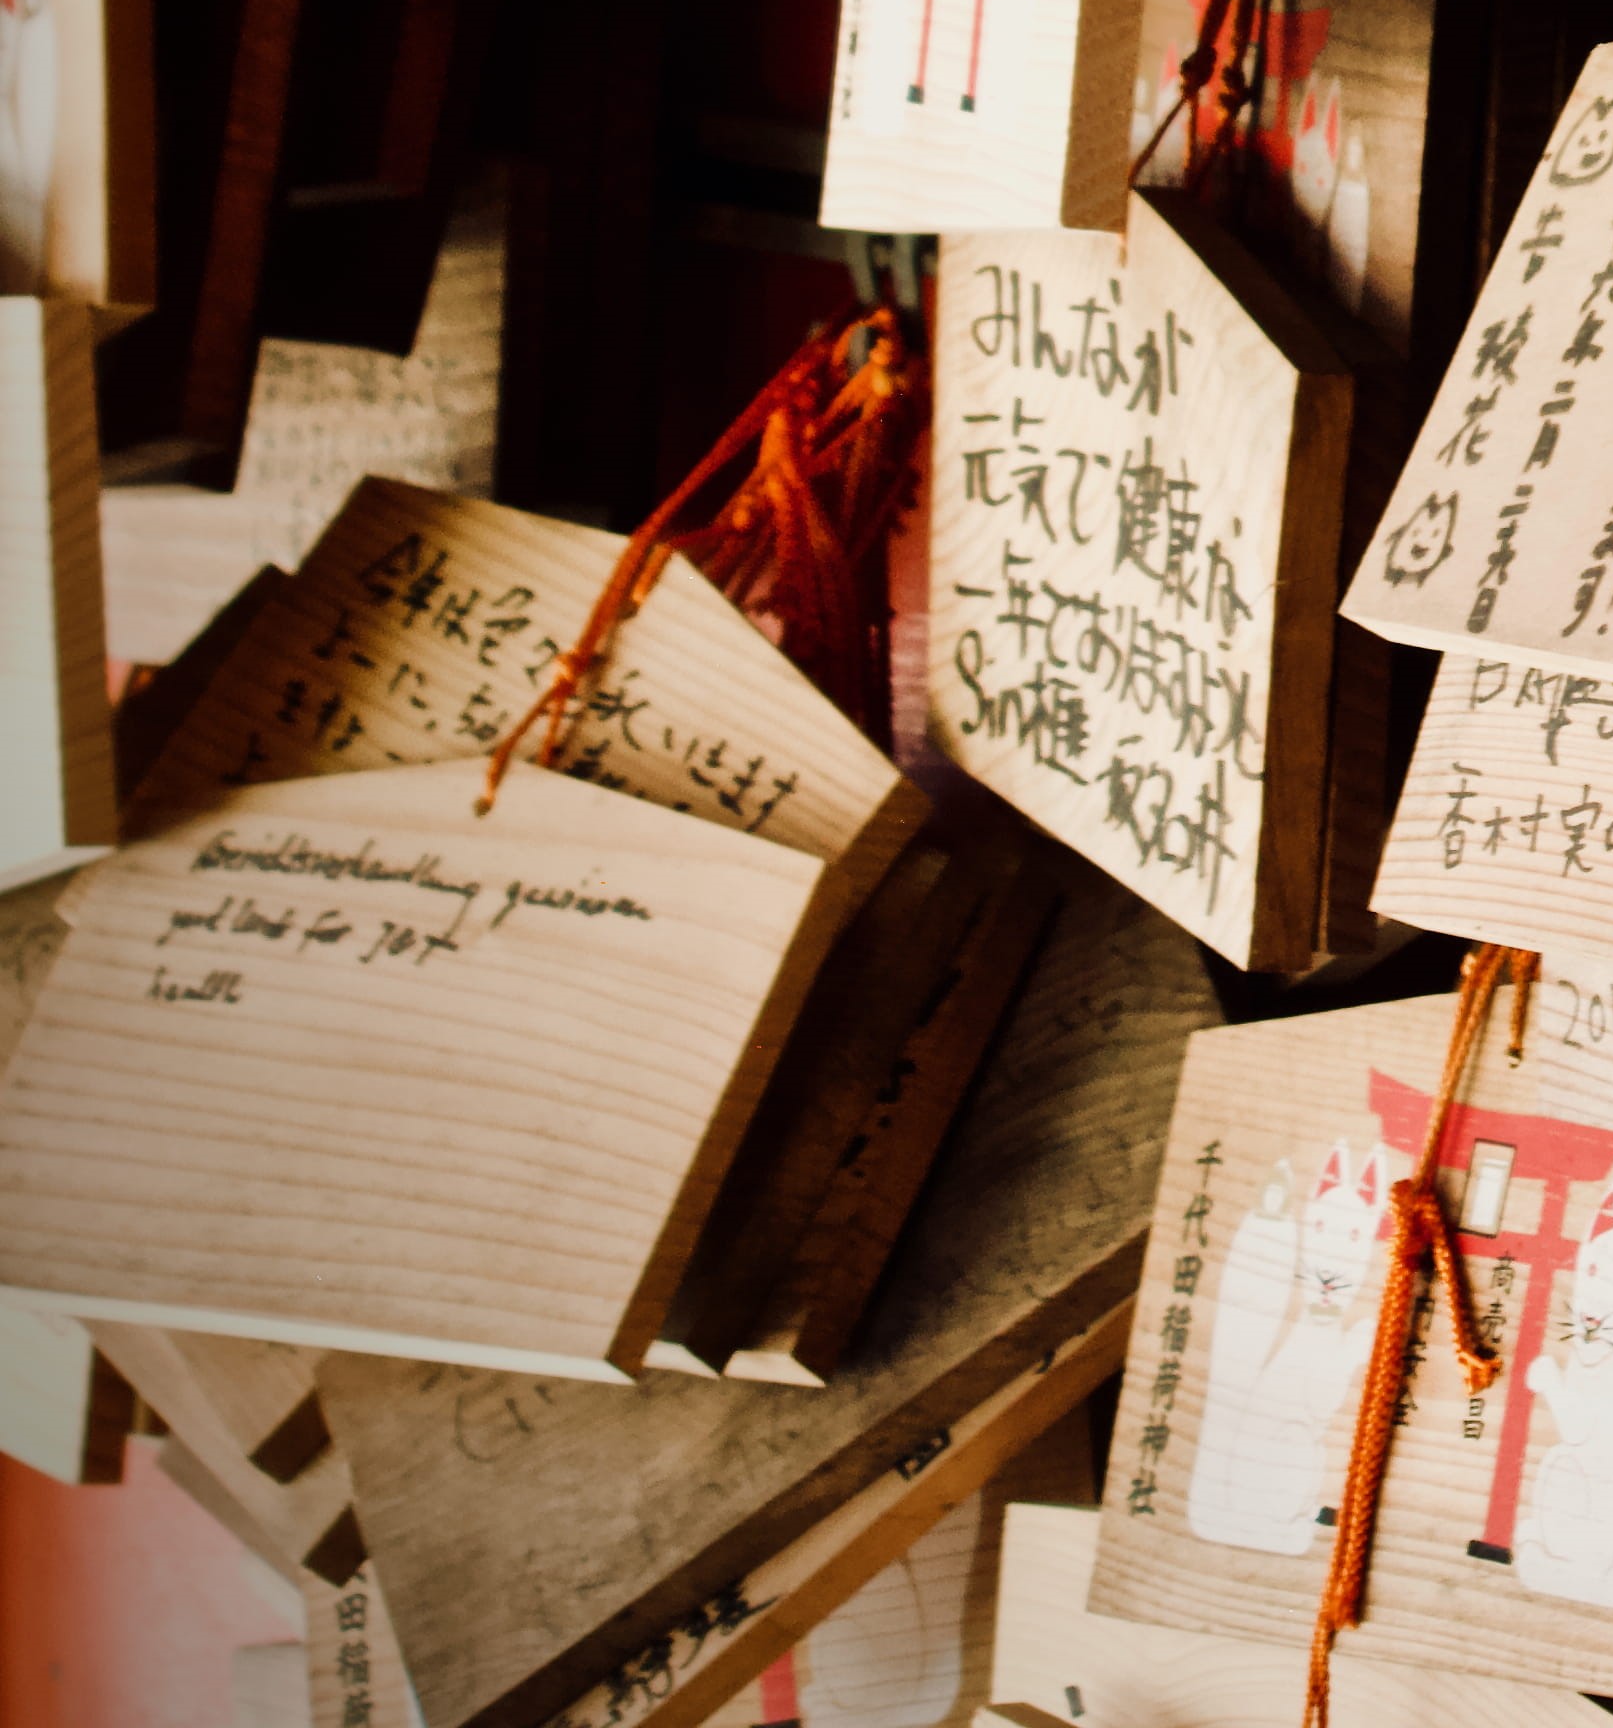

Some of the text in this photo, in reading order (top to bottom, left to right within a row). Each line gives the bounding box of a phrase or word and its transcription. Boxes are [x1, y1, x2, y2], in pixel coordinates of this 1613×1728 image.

[1127, 1138, 1224, 1518] 千代田稲荷神社
